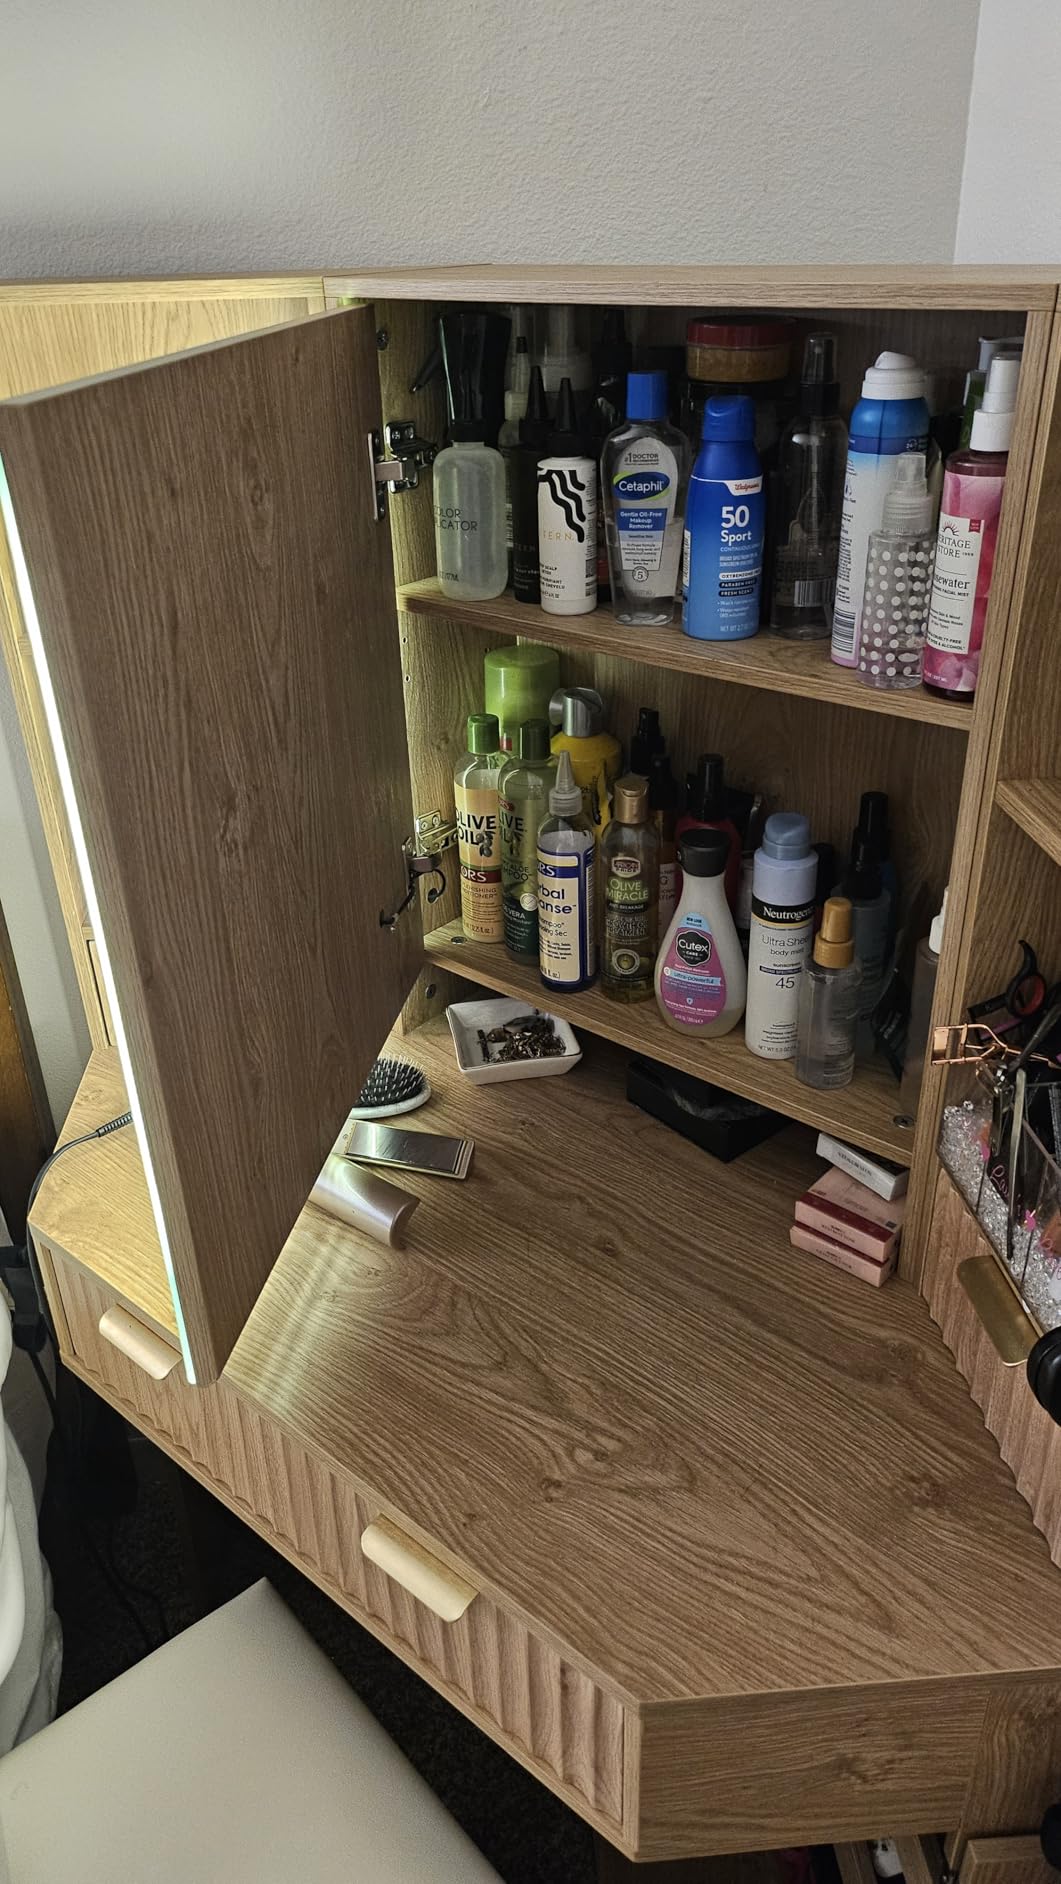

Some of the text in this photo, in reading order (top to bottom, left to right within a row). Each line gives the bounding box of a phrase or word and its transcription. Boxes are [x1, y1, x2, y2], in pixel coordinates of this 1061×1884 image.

[618, 480, 665, 493] Cetaphil
[433, 505, 462, 518] OLOR
[721, 505, 750, 529] 50
[720, 529, 752, 547] Sport
[938, 534, 972, 549] ERITAGE
[934, 575, 971, 590] sewater
[460, 865, 487, 882] ORS
[539, 863, 556, 877] RS
[610, 878, 641, 892] OLIVE
[608, 889, 649, 901] MIRACLE
[539, 899, 573, 915] anse
[763, 905, 814, 920] Neutrogen
[678, 939, 709, 953] Cutex
[761, 935, 785, 947] Ultra
[775, 976, 796, 989] 45
